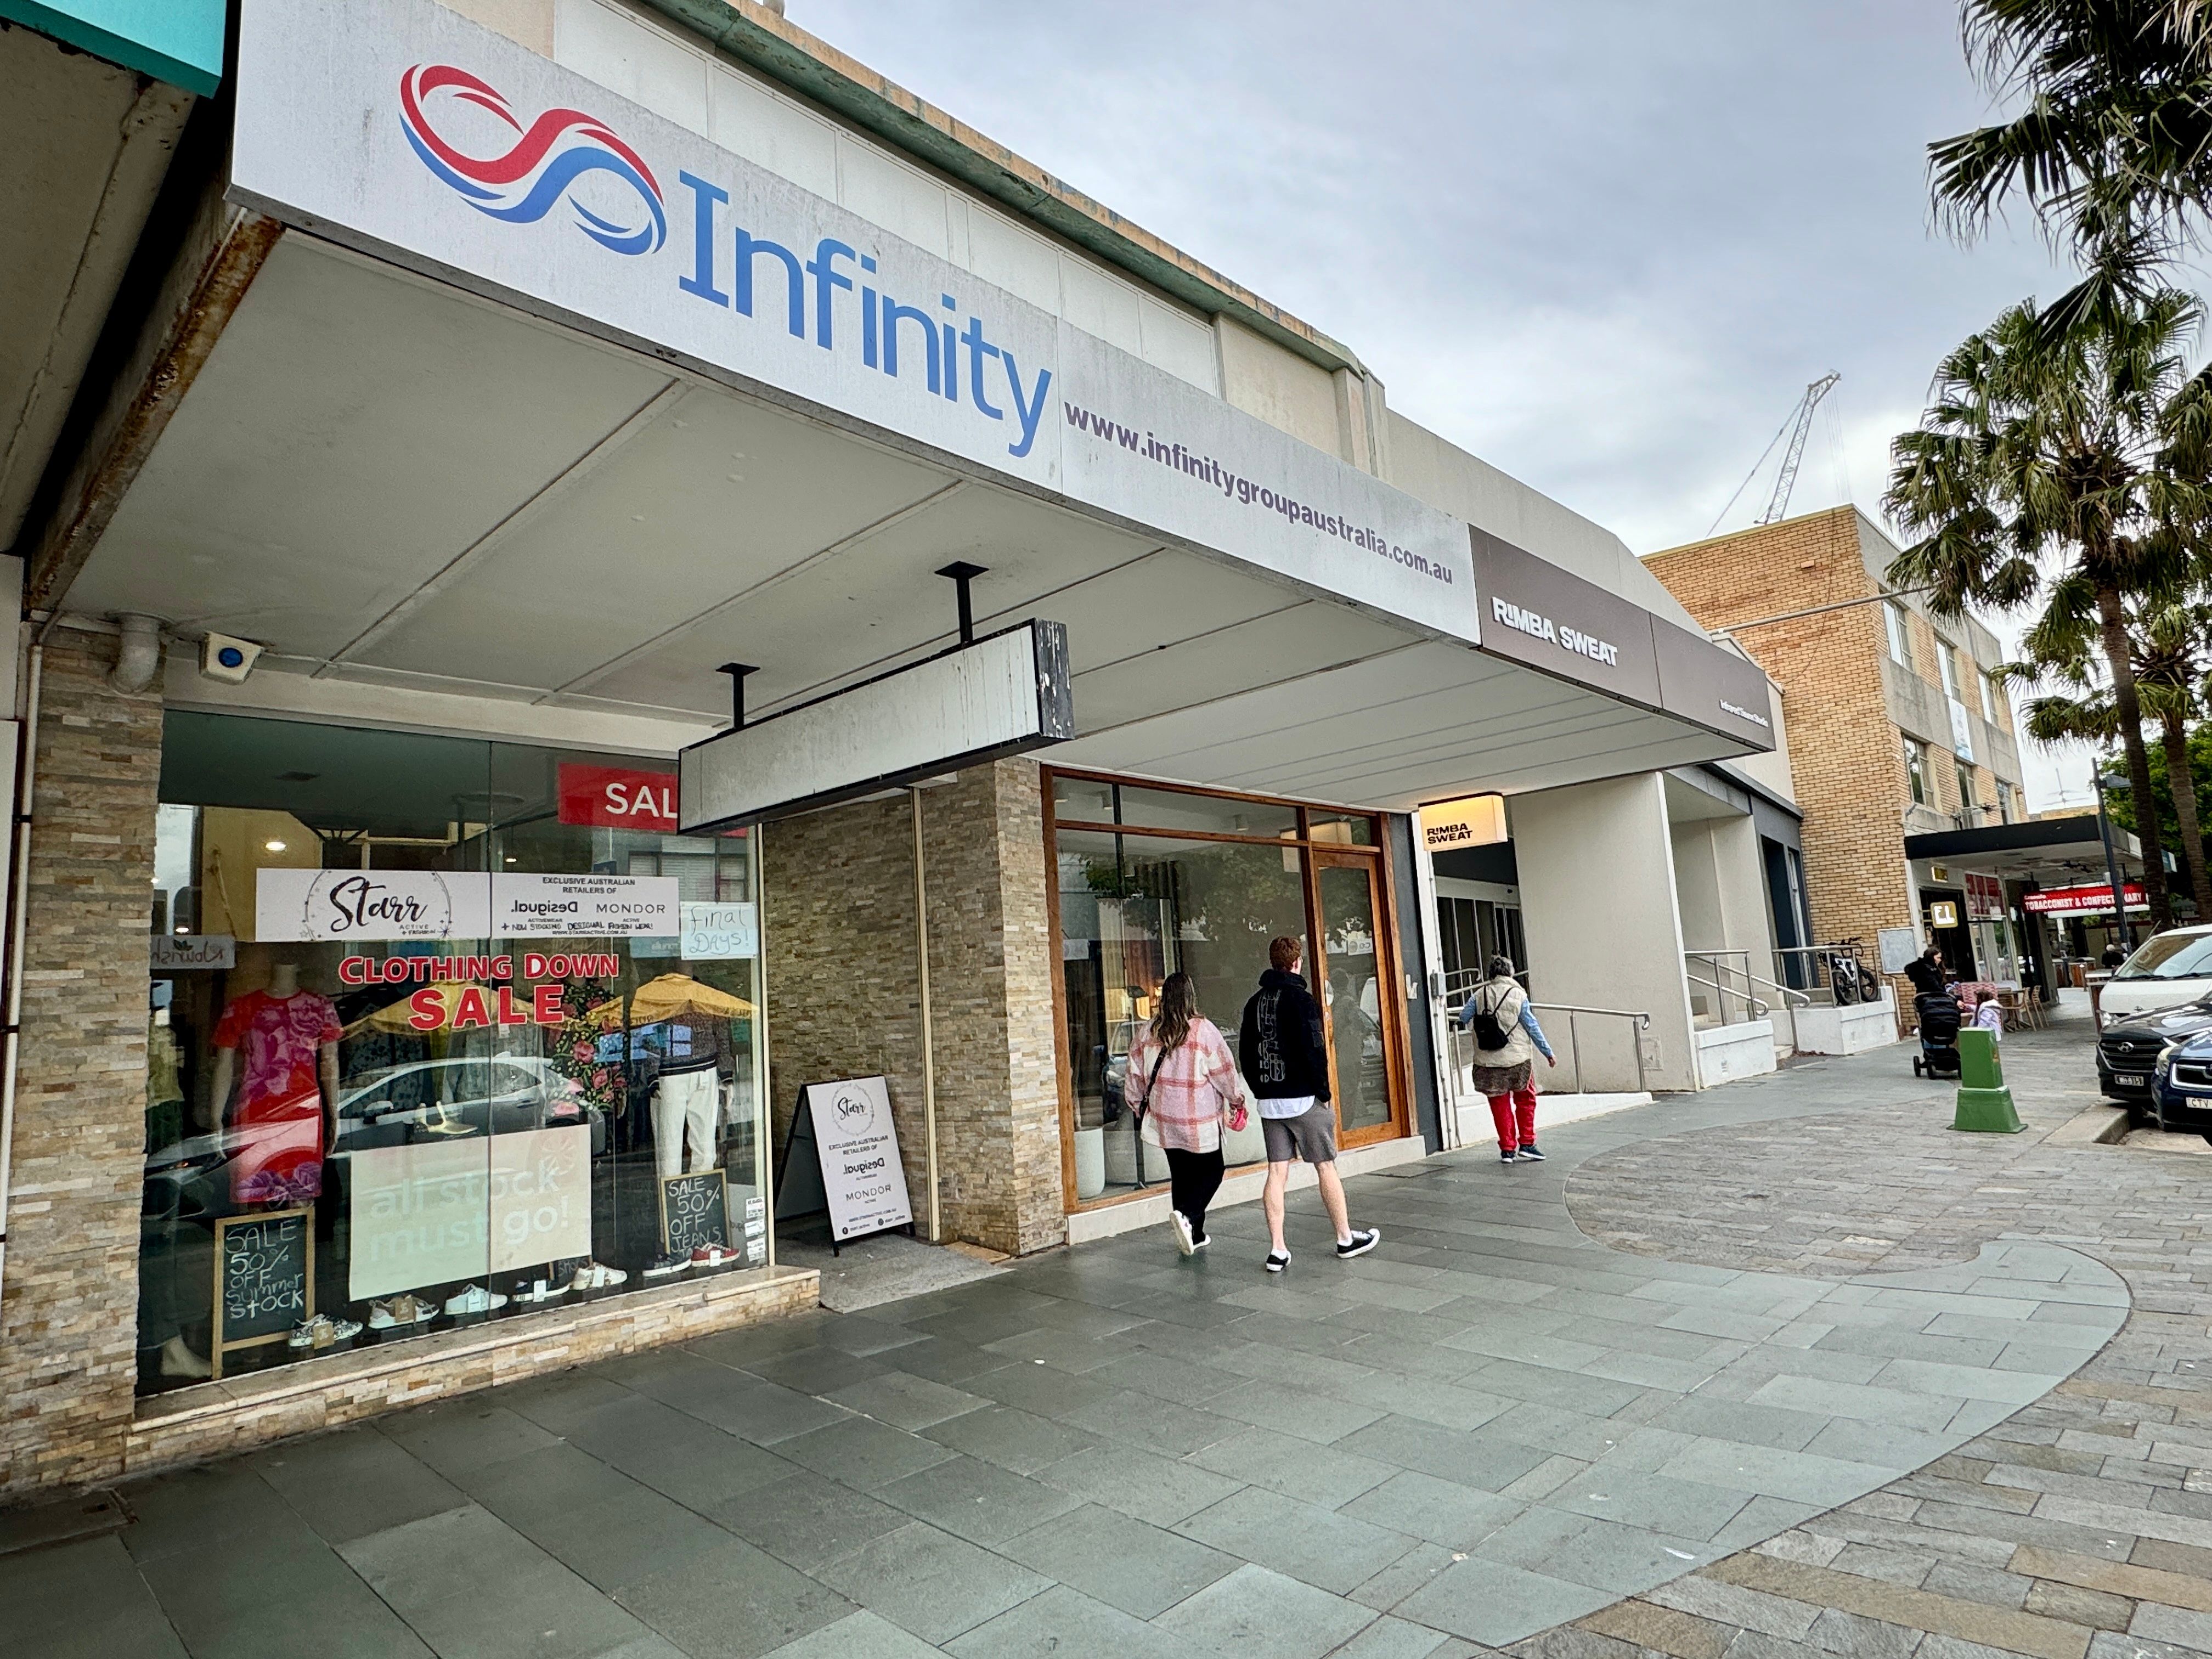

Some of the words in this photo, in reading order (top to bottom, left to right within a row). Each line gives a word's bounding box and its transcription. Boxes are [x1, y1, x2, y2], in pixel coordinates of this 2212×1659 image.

[680, 170, 1051, 458] Infinity
[1064, 402, 1453, 585] www.infinitygroupaustralia.com.au
[1559, 627, 1618, 667] SWEAT
[606, 782, 678, 819] SAL
[1427, 830, 1472, 844] SWEAT
[330, 876, 428, 932] Starr
[596, 904, 665, 914] MONDOR
[2025, 898, 2073, 911] TOBACCONIST
[2075, 897, 2082, 906] &
[2081, 892, 2142, 906] CONFECTNARY
[338, 955, 513, 985] CLOTHING
[524, 952, 619, 980] DOWN
[408, 984, 565, 1030] SALE
[837, 1096, 866, 1120] Starr
[843, 1146, 870, 1155] RETAILERS
[858, 1135, 889, 1146] AUSTRALIAN
[370, 1177, 425, 1219] all
[439, 1160, 559, 1207] stock
[668, 1177, 706, 1197] SALE
[676, 1183, 721, 1214] 50%
[845, 1184, 891, 1201] MONDOR
[225, 1219, 297, 1254] SALE
[369, 1212, 488, 1262] must
[502, 1195, 569, 1245] go!
[669, 1211, 706, 1235] OFF
[229, 1245, 289, 1275] 50%
[230, 1268, 272, 1289] OFF
